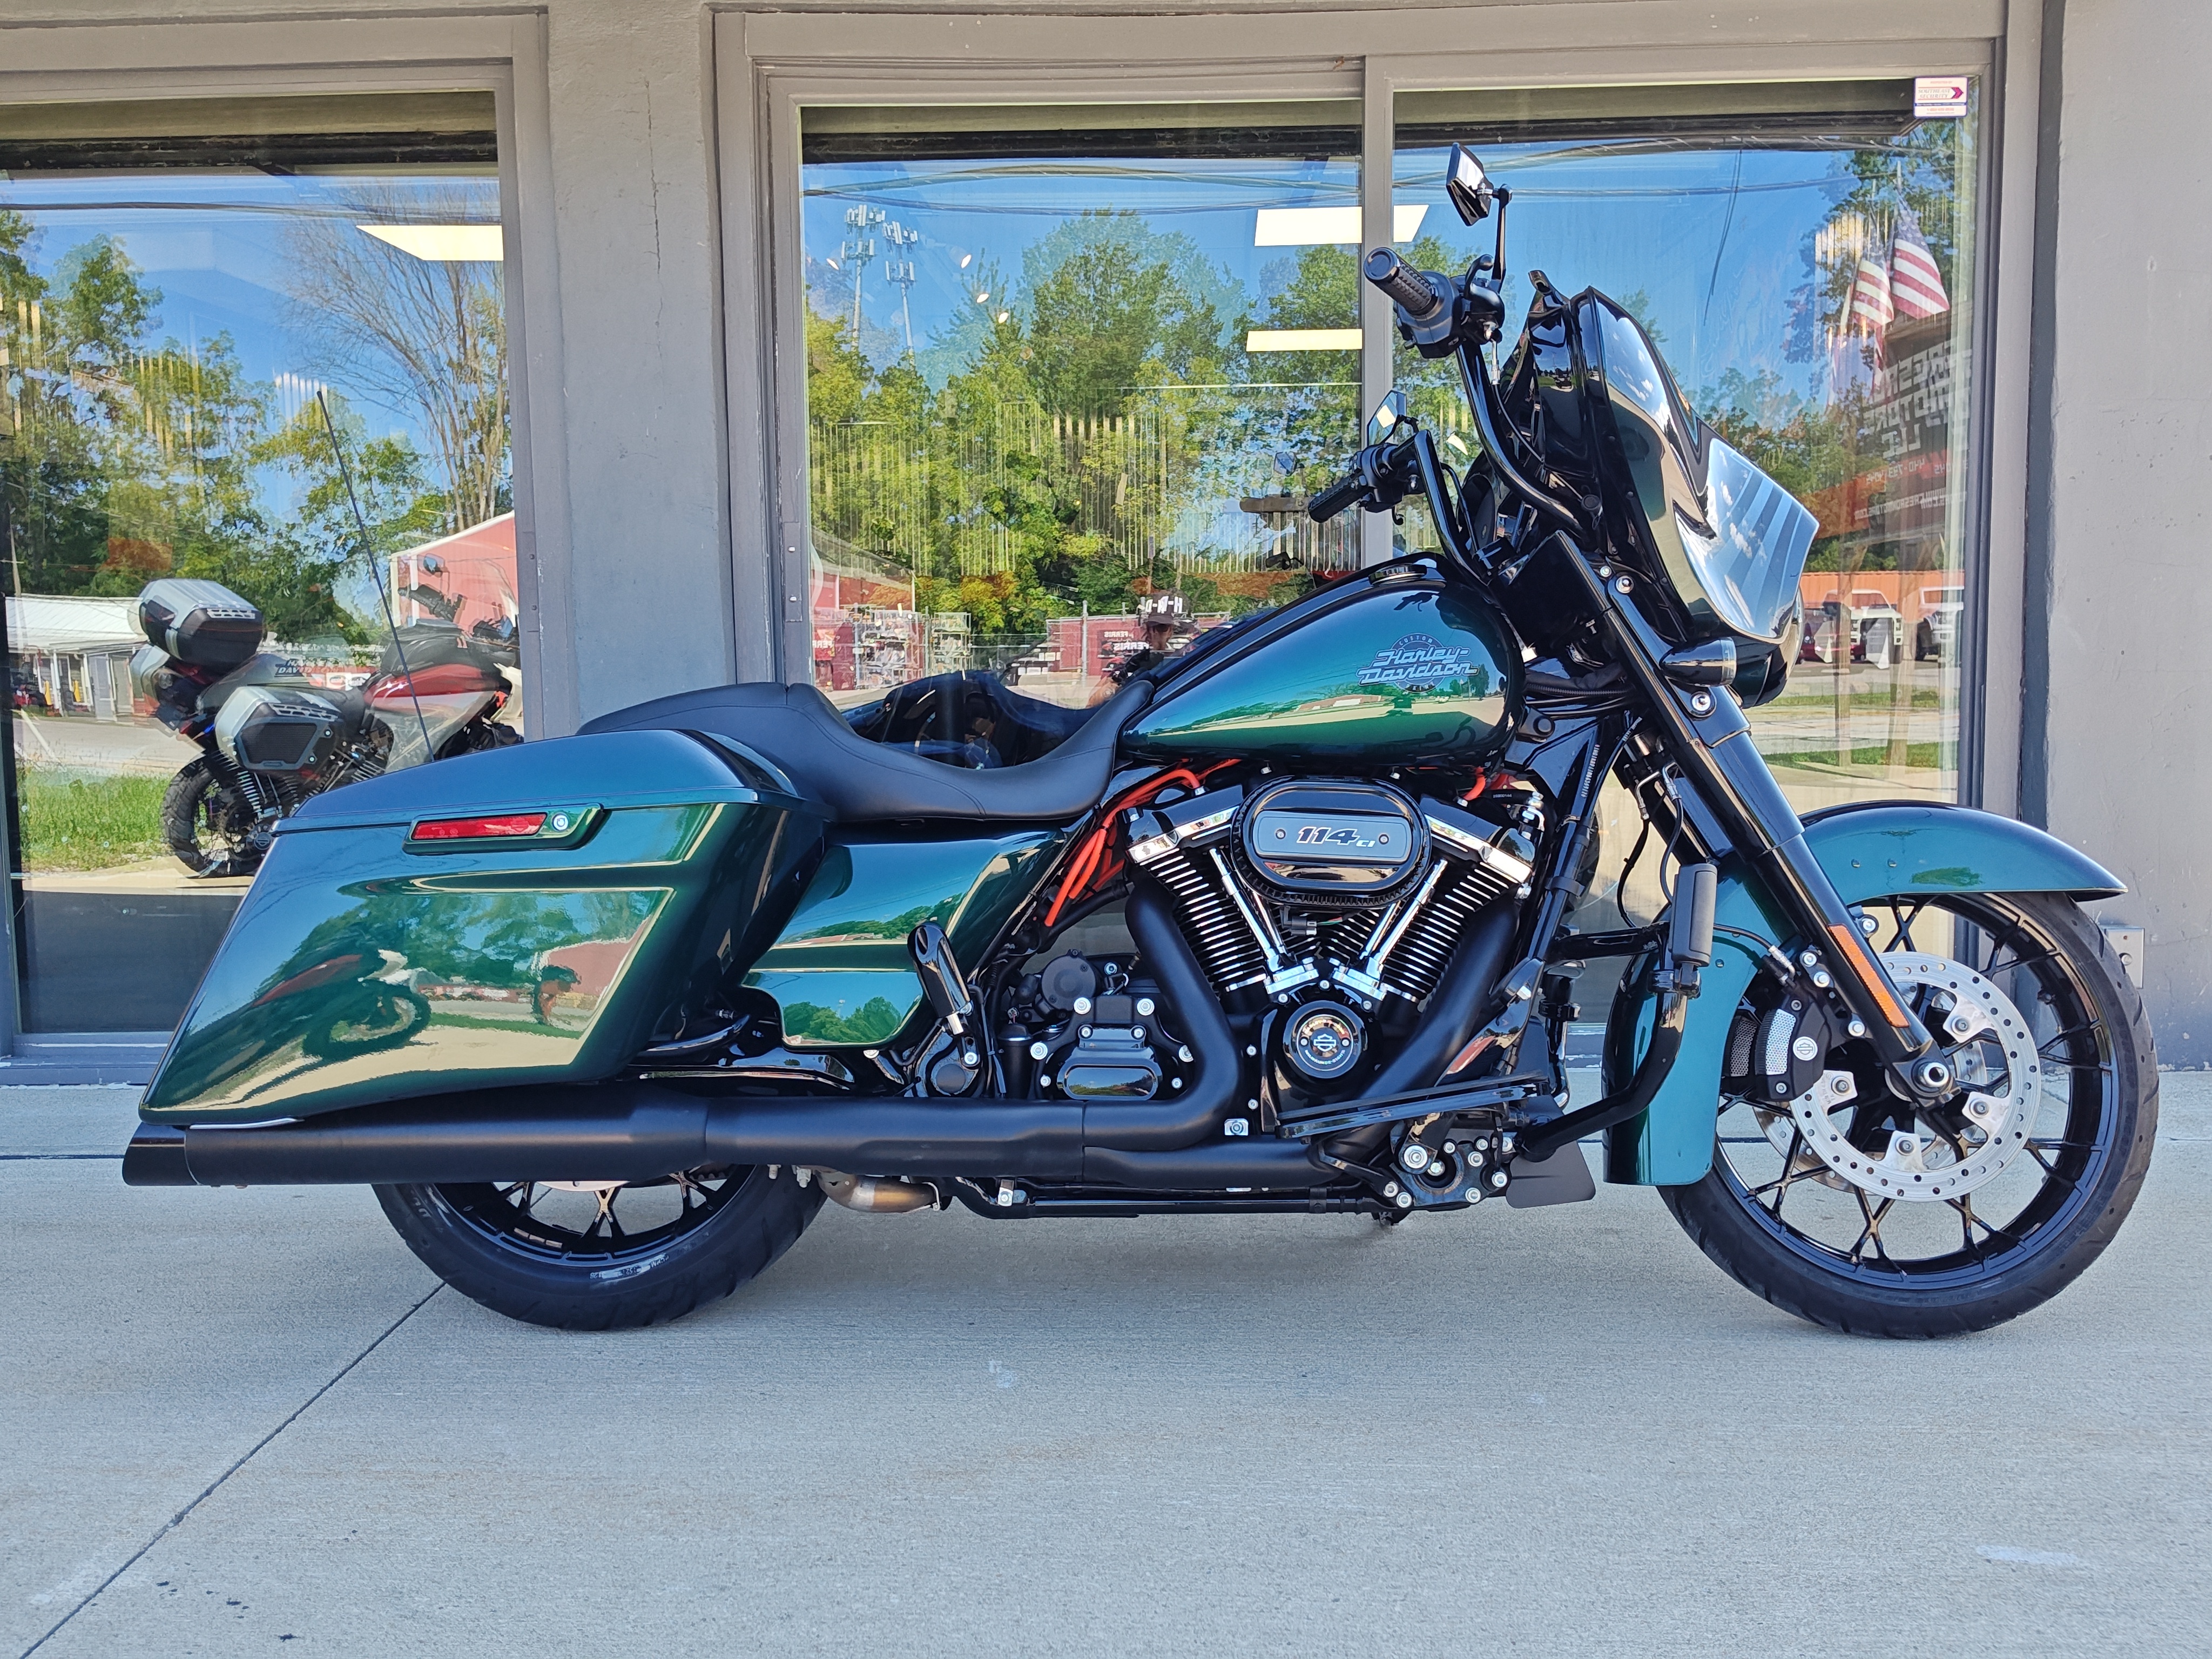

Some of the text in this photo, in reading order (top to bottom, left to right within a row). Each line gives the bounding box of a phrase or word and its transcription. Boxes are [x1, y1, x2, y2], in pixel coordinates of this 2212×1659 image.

[1399, 635, 1433, 646] CUSTOM
[1357, 662, 1479, 685] Davidson
[1296, 826, 1360, 846] 114
